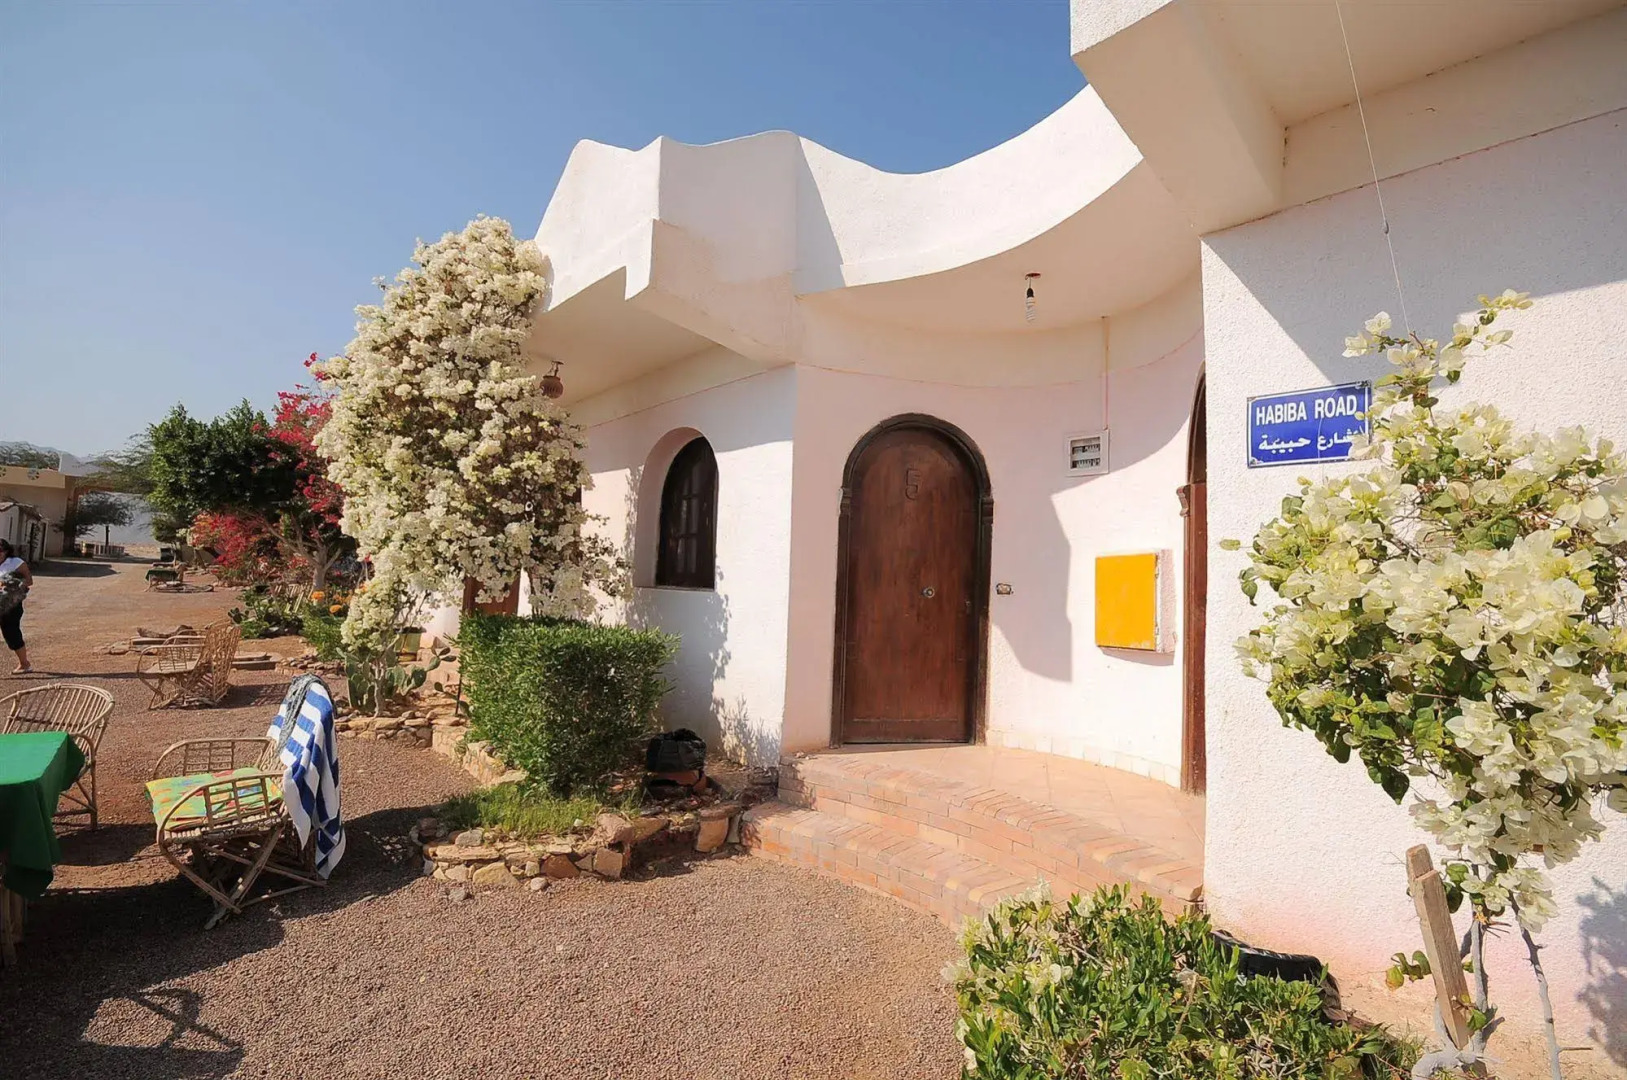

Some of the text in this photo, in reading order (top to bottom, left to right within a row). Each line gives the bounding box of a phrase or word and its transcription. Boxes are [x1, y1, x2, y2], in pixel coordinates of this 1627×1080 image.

[1256, 395, 1357, 426] HABIBA ROAD
[1258, 434, 1311, 454] حبيبة
[905, 467, 920, 501] 5
